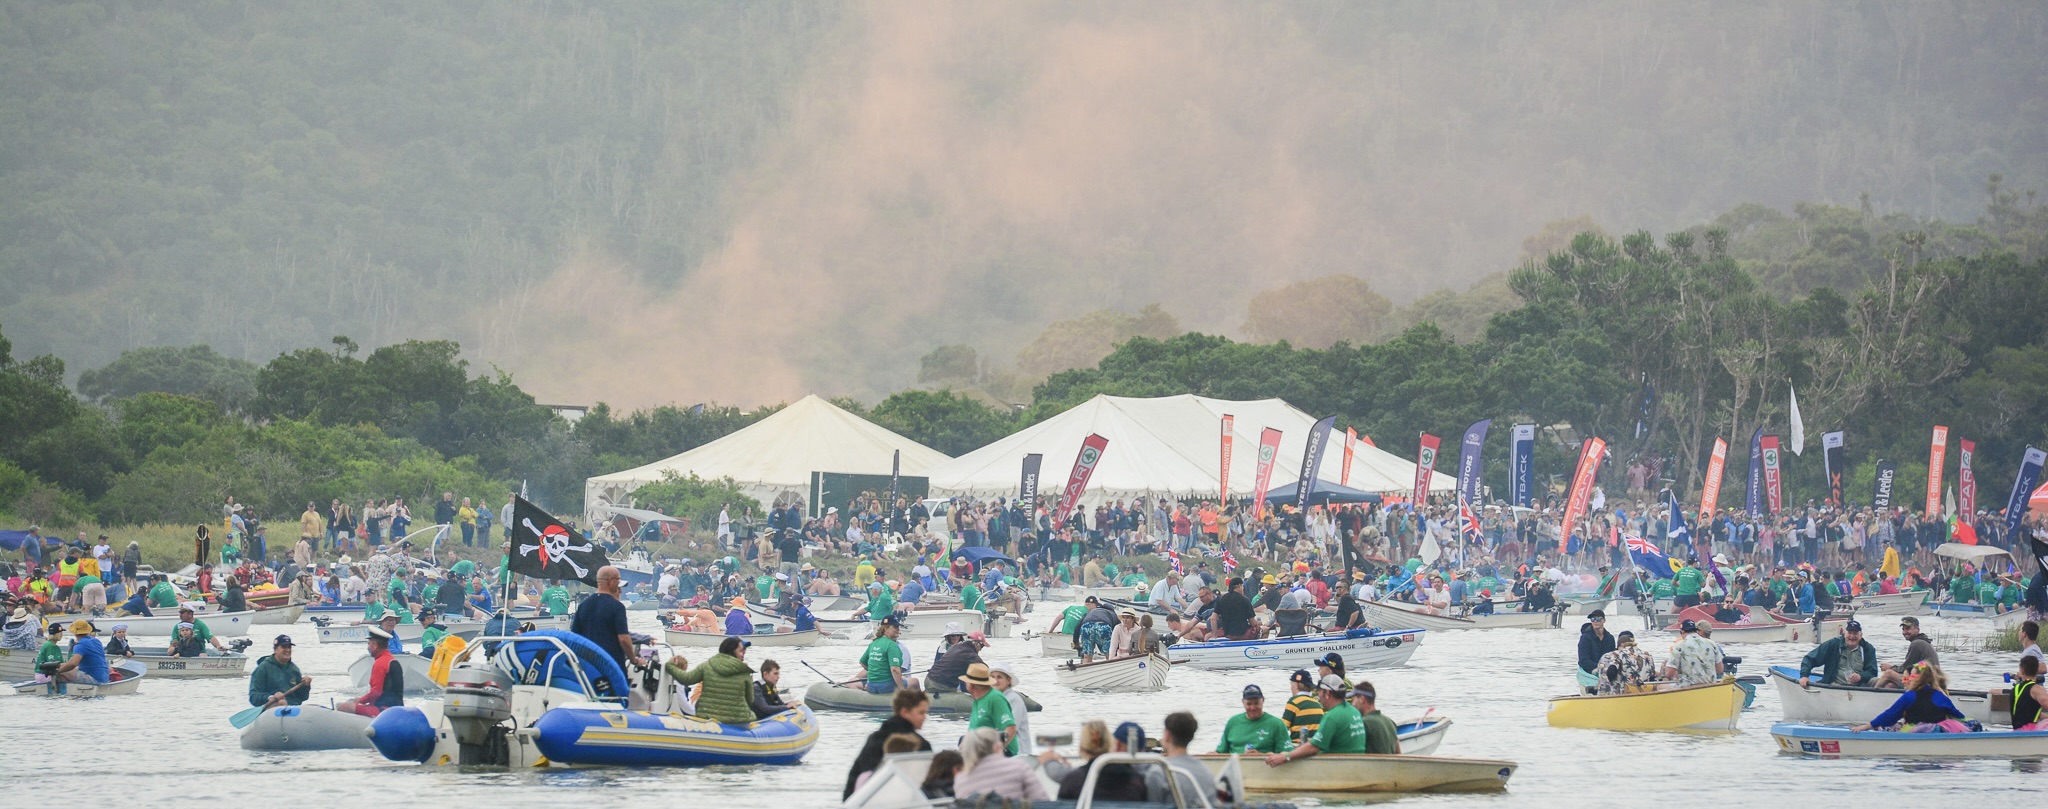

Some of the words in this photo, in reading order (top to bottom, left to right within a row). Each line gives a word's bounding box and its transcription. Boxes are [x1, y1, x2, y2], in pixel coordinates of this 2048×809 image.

[1304, 431, 1321, 478] MOTORS
[1024, 474, 1036, 497] Leedes
[1462, 455, 1473, 493] MOTORS
[1876, 469, 1894, 498] Leedes
[1319, 644, 1356, 652] CHALLENGE
